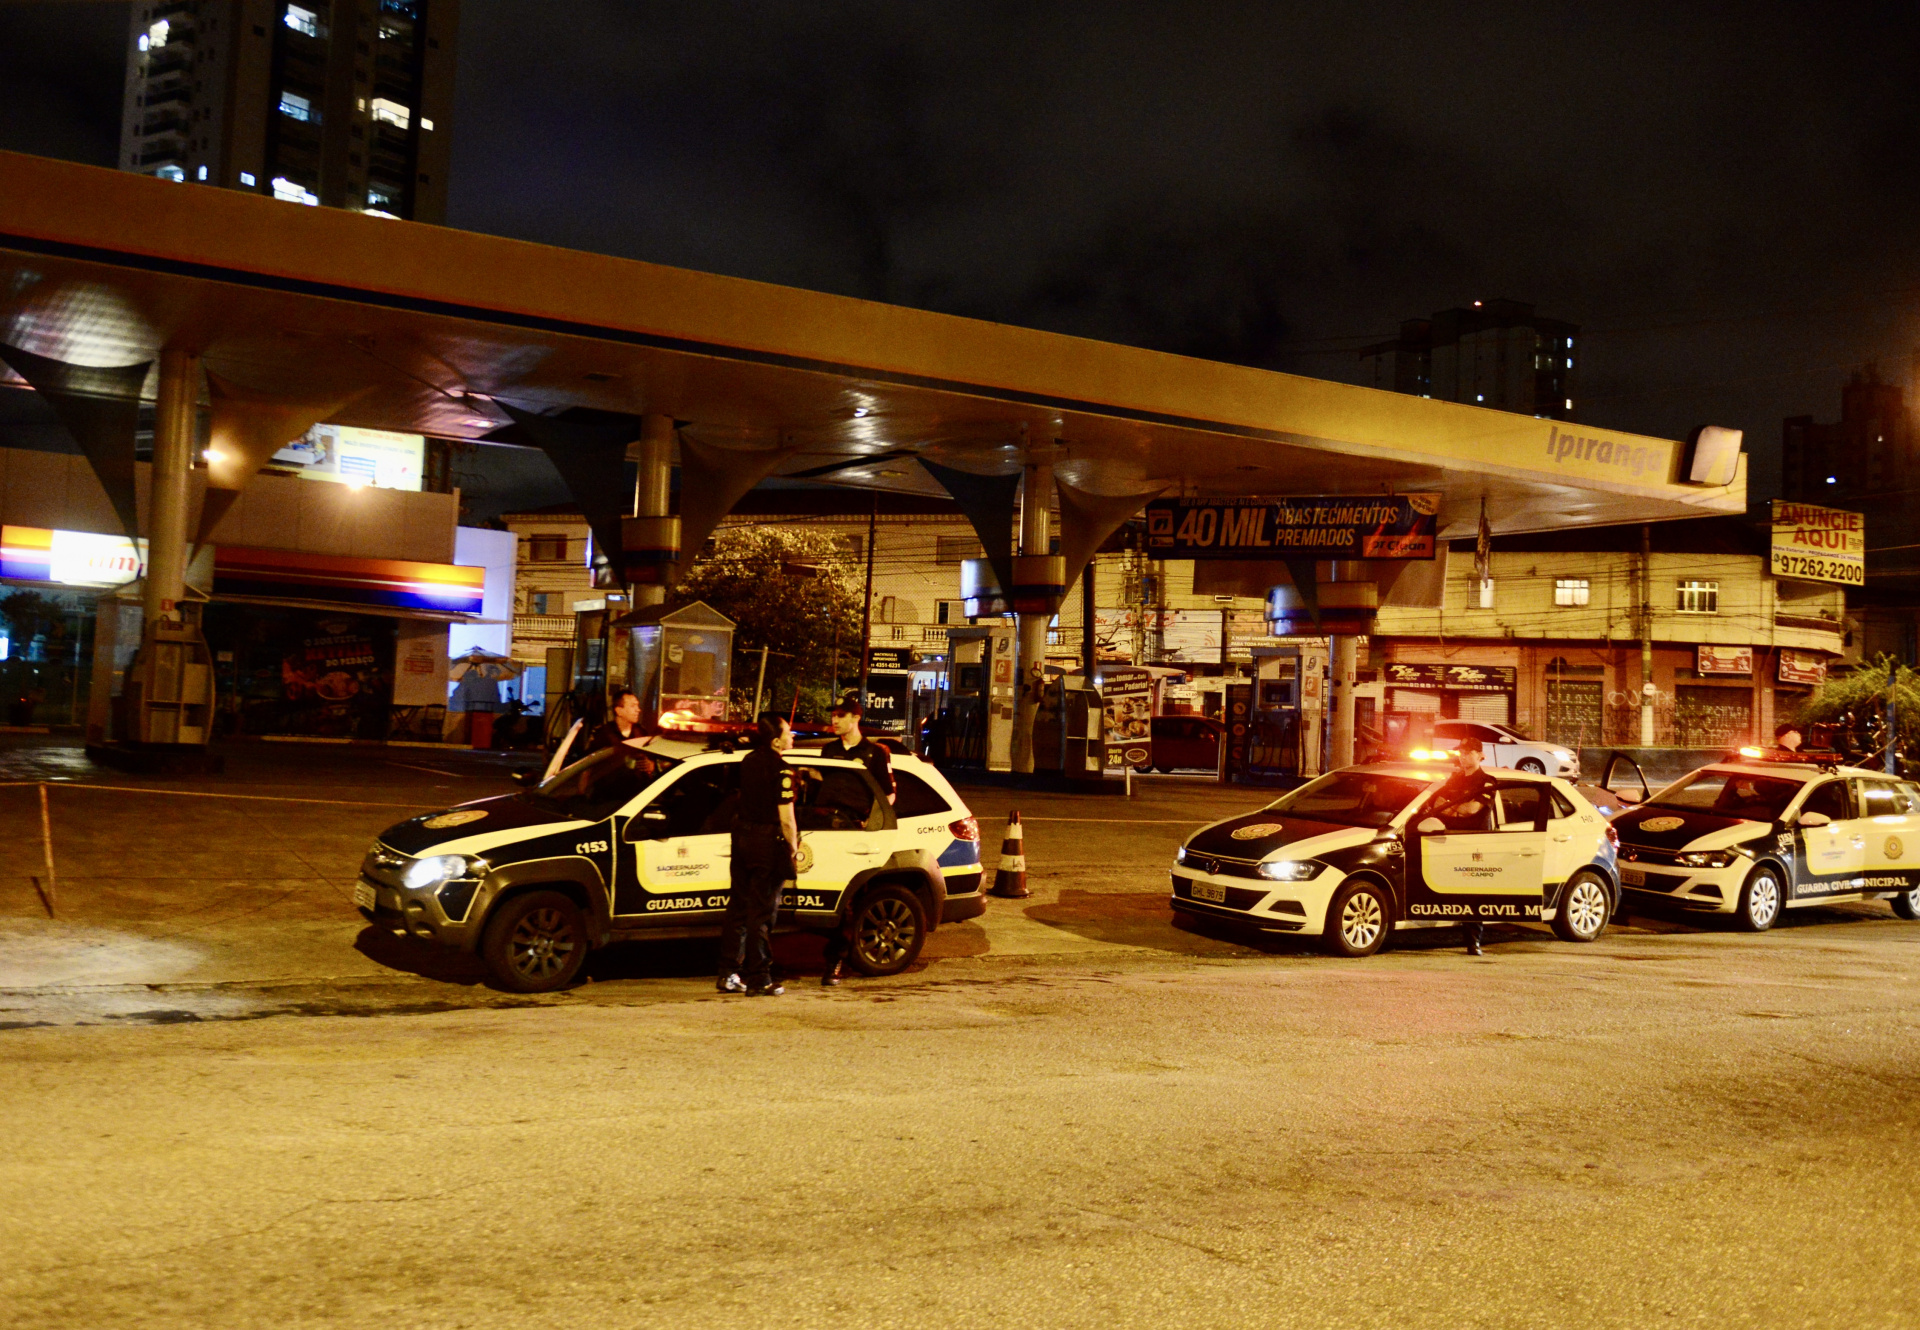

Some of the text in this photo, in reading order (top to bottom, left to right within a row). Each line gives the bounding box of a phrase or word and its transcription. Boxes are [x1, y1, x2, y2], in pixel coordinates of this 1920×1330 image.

[1547, 426, 1662, 476] Ipiranga
[1275, 506, 1399, 525] ABASTECIMENTOS
[1779, 504, 1859, 532] ANUNCIE
[1176, 508, 1271, 547] 40 MIL
[1275, 528, 1356, 546] PREMIADOS
[1793, 527, 1847, 550] AQUI
[1781, 555, 1862, 583] 97262-2200
[1116, 674, 1133, 682] tomar
[1124, 681, 1148, 691] Padaria!
[866, 692, 894, 709] Fort
[917, 826, 946, 835] GCM-01
[1797, 882, 1831, 894] GUARDA
[1831, 880, 1852, 890] CIVIL
[646, 895, 824, 911] GUARDA CIV ICIPAL
[1410, 903, 1473, 916] GUARDA
[1478, 904, 1520, 916] CIVIL
